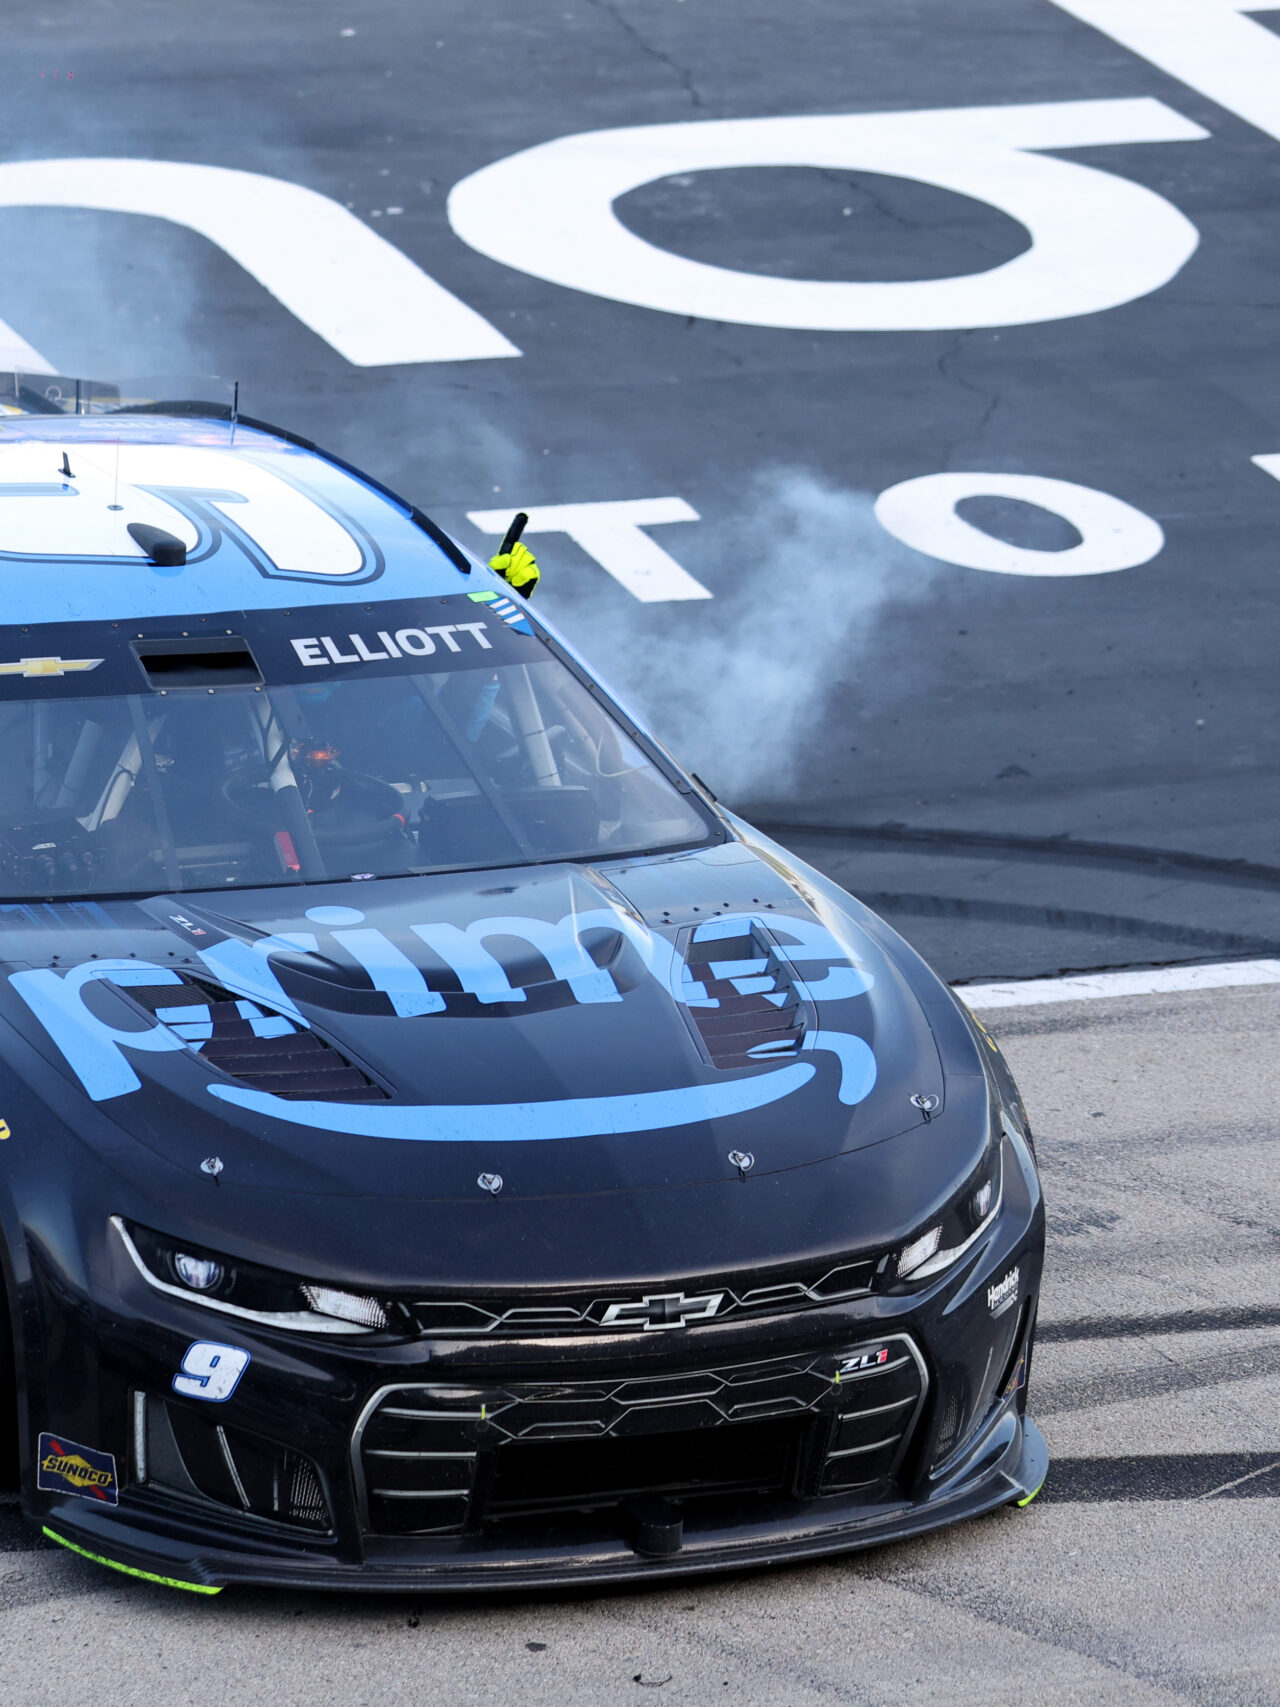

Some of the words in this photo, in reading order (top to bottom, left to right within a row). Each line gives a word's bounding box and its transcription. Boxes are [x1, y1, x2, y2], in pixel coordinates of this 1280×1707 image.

[290, 621, 493, 667] ELLIOTT
[7, 905, 876, 1103] prime
[987, 1266, 1020, 1310] Hendrick
[172, 1340, 252, 1403] 9
[839, 1348, 889, 1374] ZL1
[43, 1456, 112, 1487] SUNOCO
